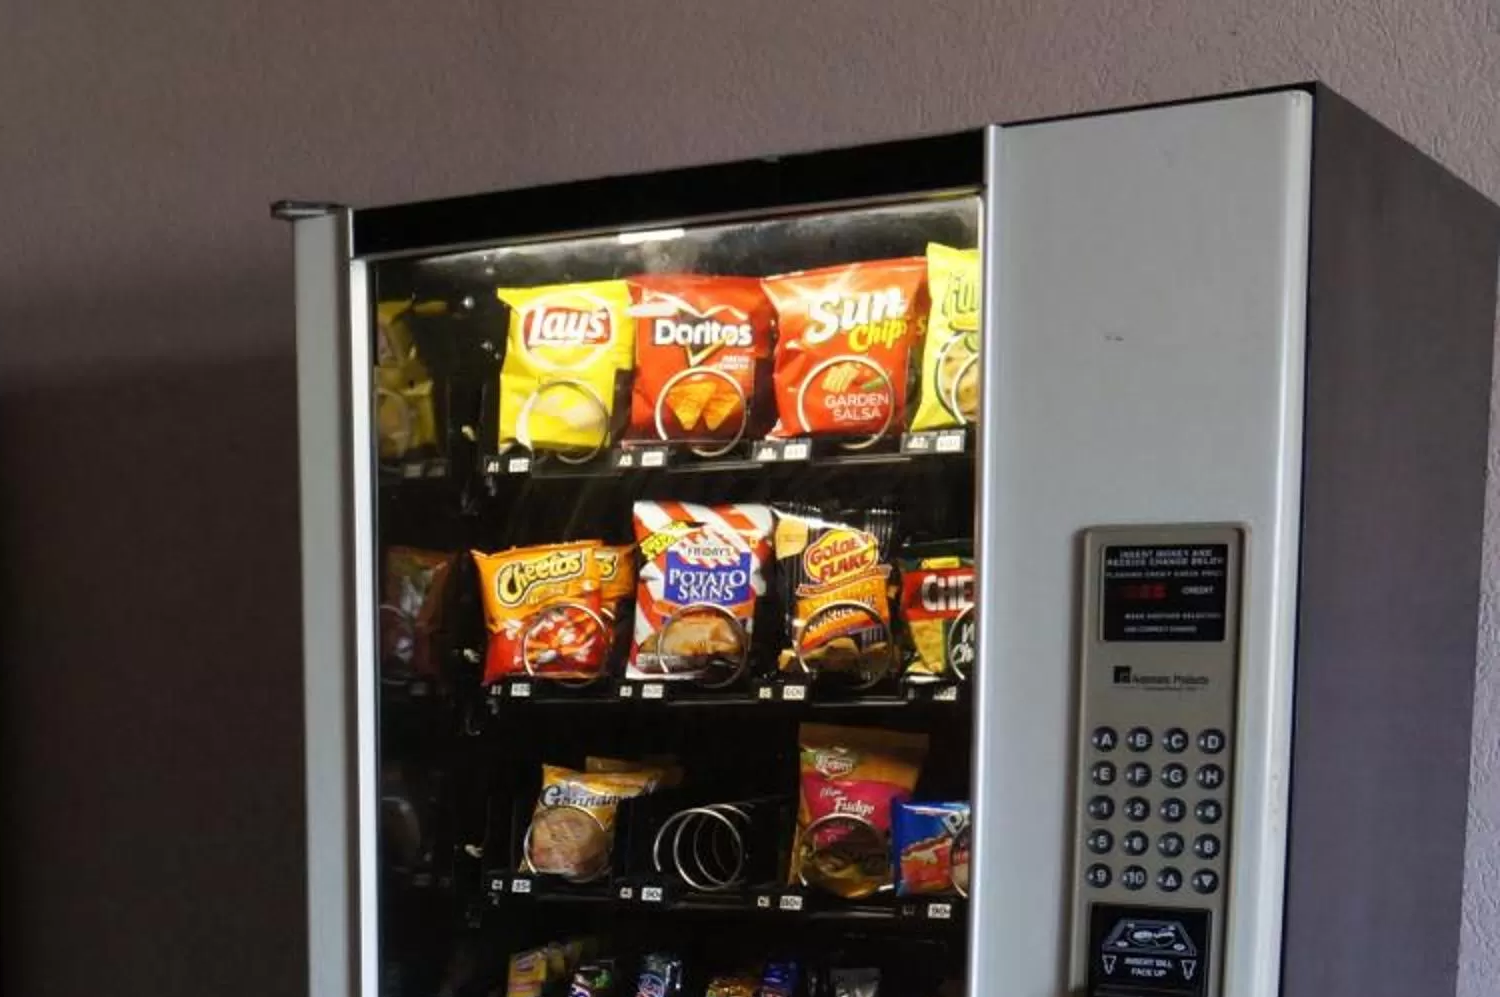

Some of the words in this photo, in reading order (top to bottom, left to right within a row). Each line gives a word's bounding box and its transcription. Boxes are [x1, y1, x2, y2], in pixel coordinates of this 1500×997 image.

[804, 287, 908, 345] Sun
[654, 318, 752, 345] Doritos
[825, 393, 889, 408] GARDEN
[833, 407, 882, 421] SALSA
[498, 550, 583, 604] Cheetos
[669, 567, 747, 589] POTATO
[677, 585, 735, 601] SKINS
